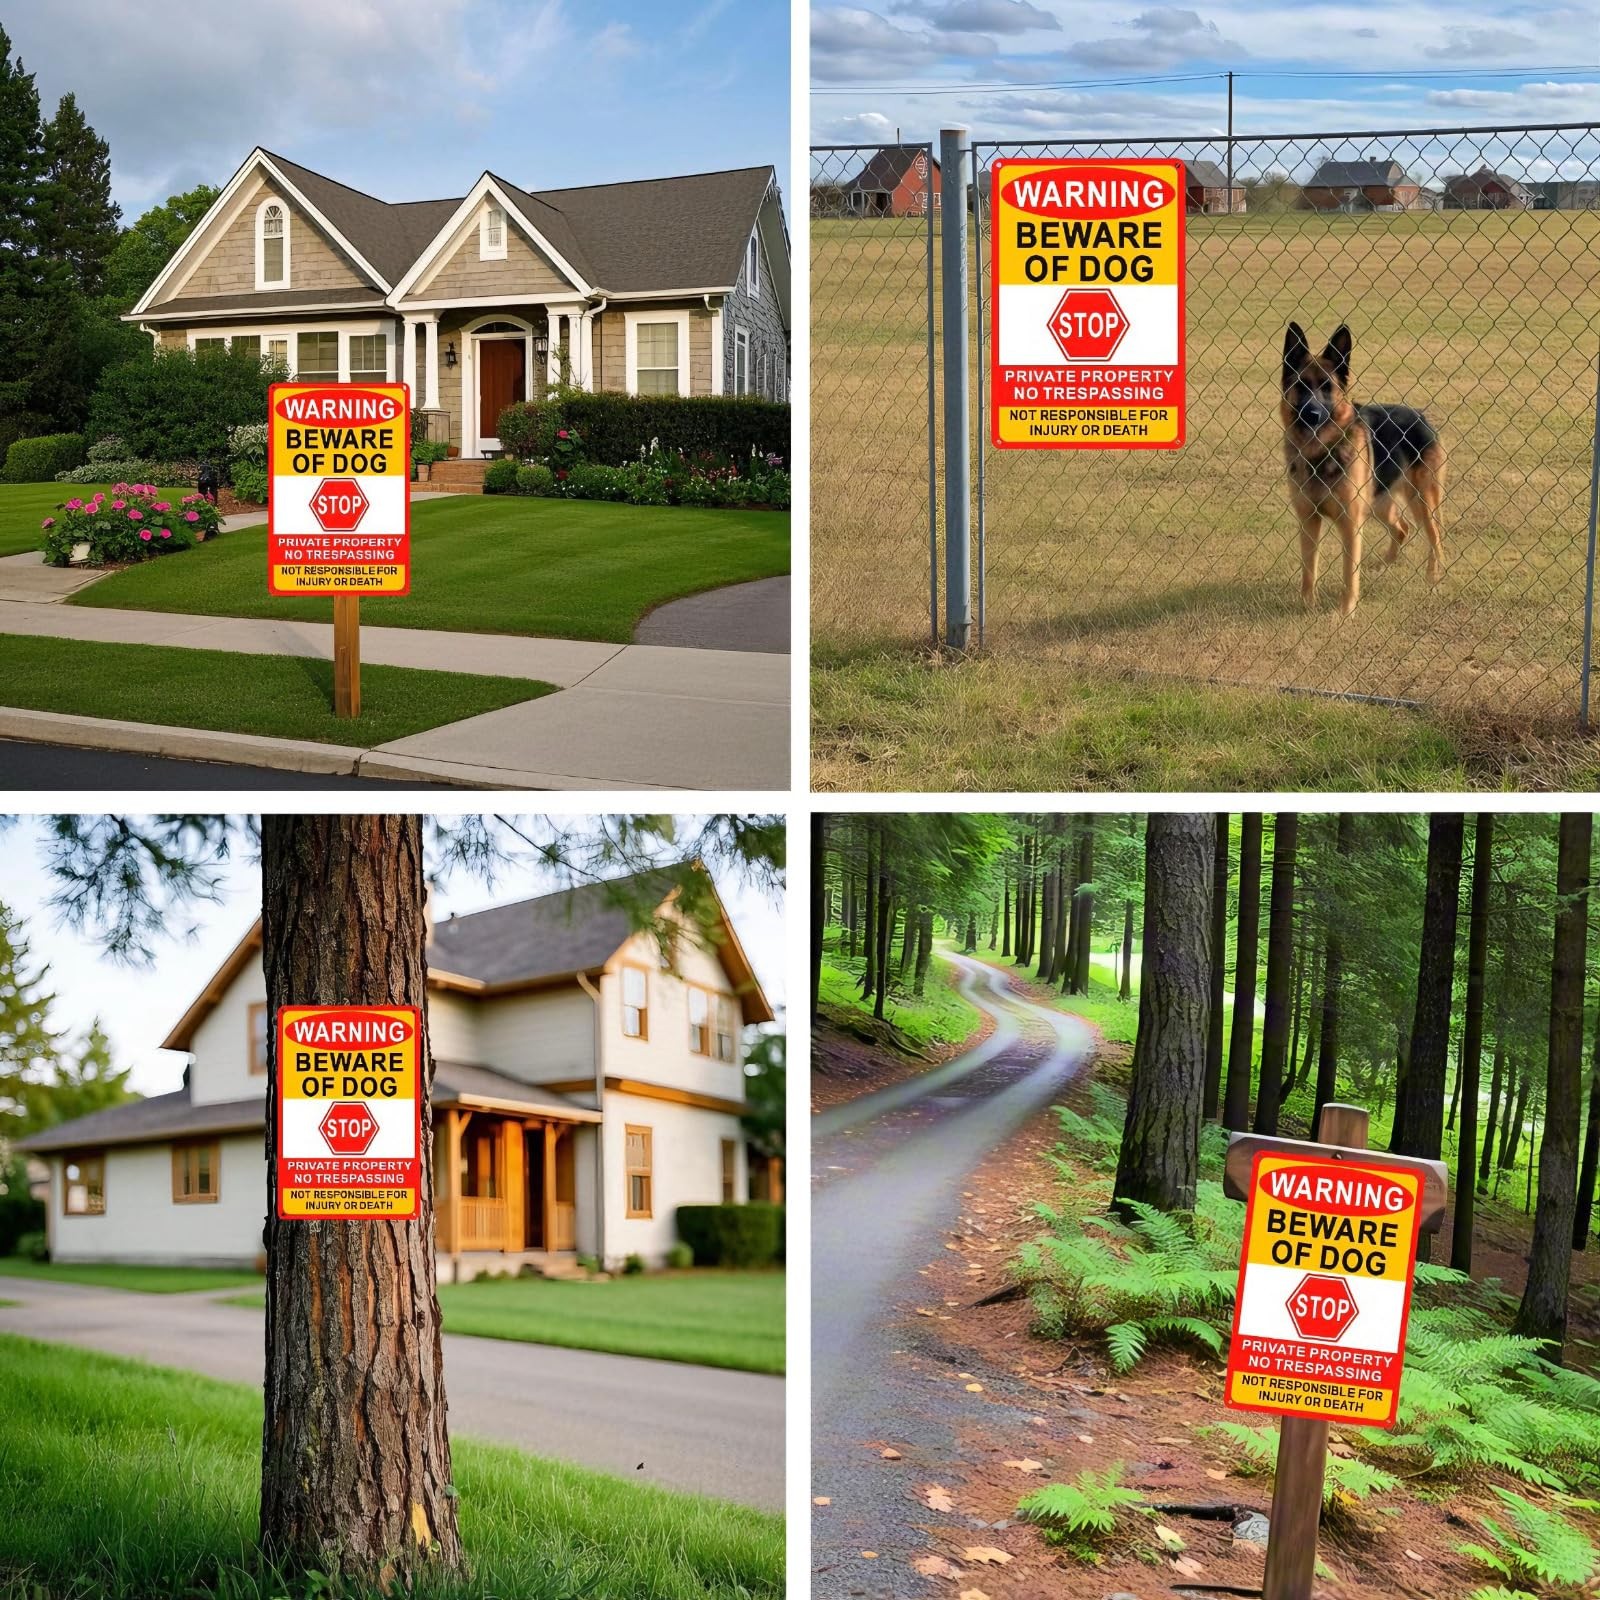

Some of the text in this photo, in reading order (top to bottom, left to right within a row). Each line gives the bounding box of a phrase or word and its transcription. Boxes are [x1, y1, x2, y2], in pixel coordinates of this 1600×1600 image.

[1014, 181, 1164, 208] WARNING
[1016, 222, 1162, 248] BEWARE
[1025, 255, 1154, 282] OF DOG
[1059, 312, 1119, 338] STOP
[1005, 370, 1173, 383] PRIVATE PROPERTY
[1014, 386, 1164, 400] NO TRESPASSING
[285, 399, 395, 419] WARNING
[1010, 409, 1168, 421] NOT RESPONSIBLE FOR
[286, 429, 393, 448] BEWARE
[1030, 425, 1148, 436] INJURY OR DEATH
[293, 453, 387, 473] OF DOG
[317, 495, 362, 515] STOP
[278, 538, 401, 547] PRIVATE PROPERTY
[285, 550, 394, 559] NO TRESPASSING
[282, 566, 397, 575] NOT RESPONSIBLE FOR
[296, 577, 383, 586] INJURY OR DEATH
[294, 1021, 404, 1042] WARNING
[296, 1053, 403, 1072] BEWARE
[302, 1077, 397, 1097] OF DOG
[327, 1119, 372, 1138] STOP
[288, 1162, 412, 1170] PRIVATE PROPERTY
[294, 1174, 404, 1183] NO TRESPASSING
[291, 1190, 407, 1199] NOT RESPONSIBLE FOR
[1271, 1171, 1404, 1211] WARNING
[306, 1201, 393, 1210] INJURY OR DEATH
[1267, 1209, 1399, 1248] BEWARE
[1272, 1240, 1386, 1276] OF DOG
[1296, 1294, 1350, 1322] STOP
[1242, 1340, 1393, 1368] PRIVATE PROPERTY
[1248, 1355, 1382, 1382] NO TRESPASSING
[1242, 1375, 1383, 1401] NOT RESPONSIBLE FOR
[1259, 1390, 1364, 1412] INJURY OR DEATH
